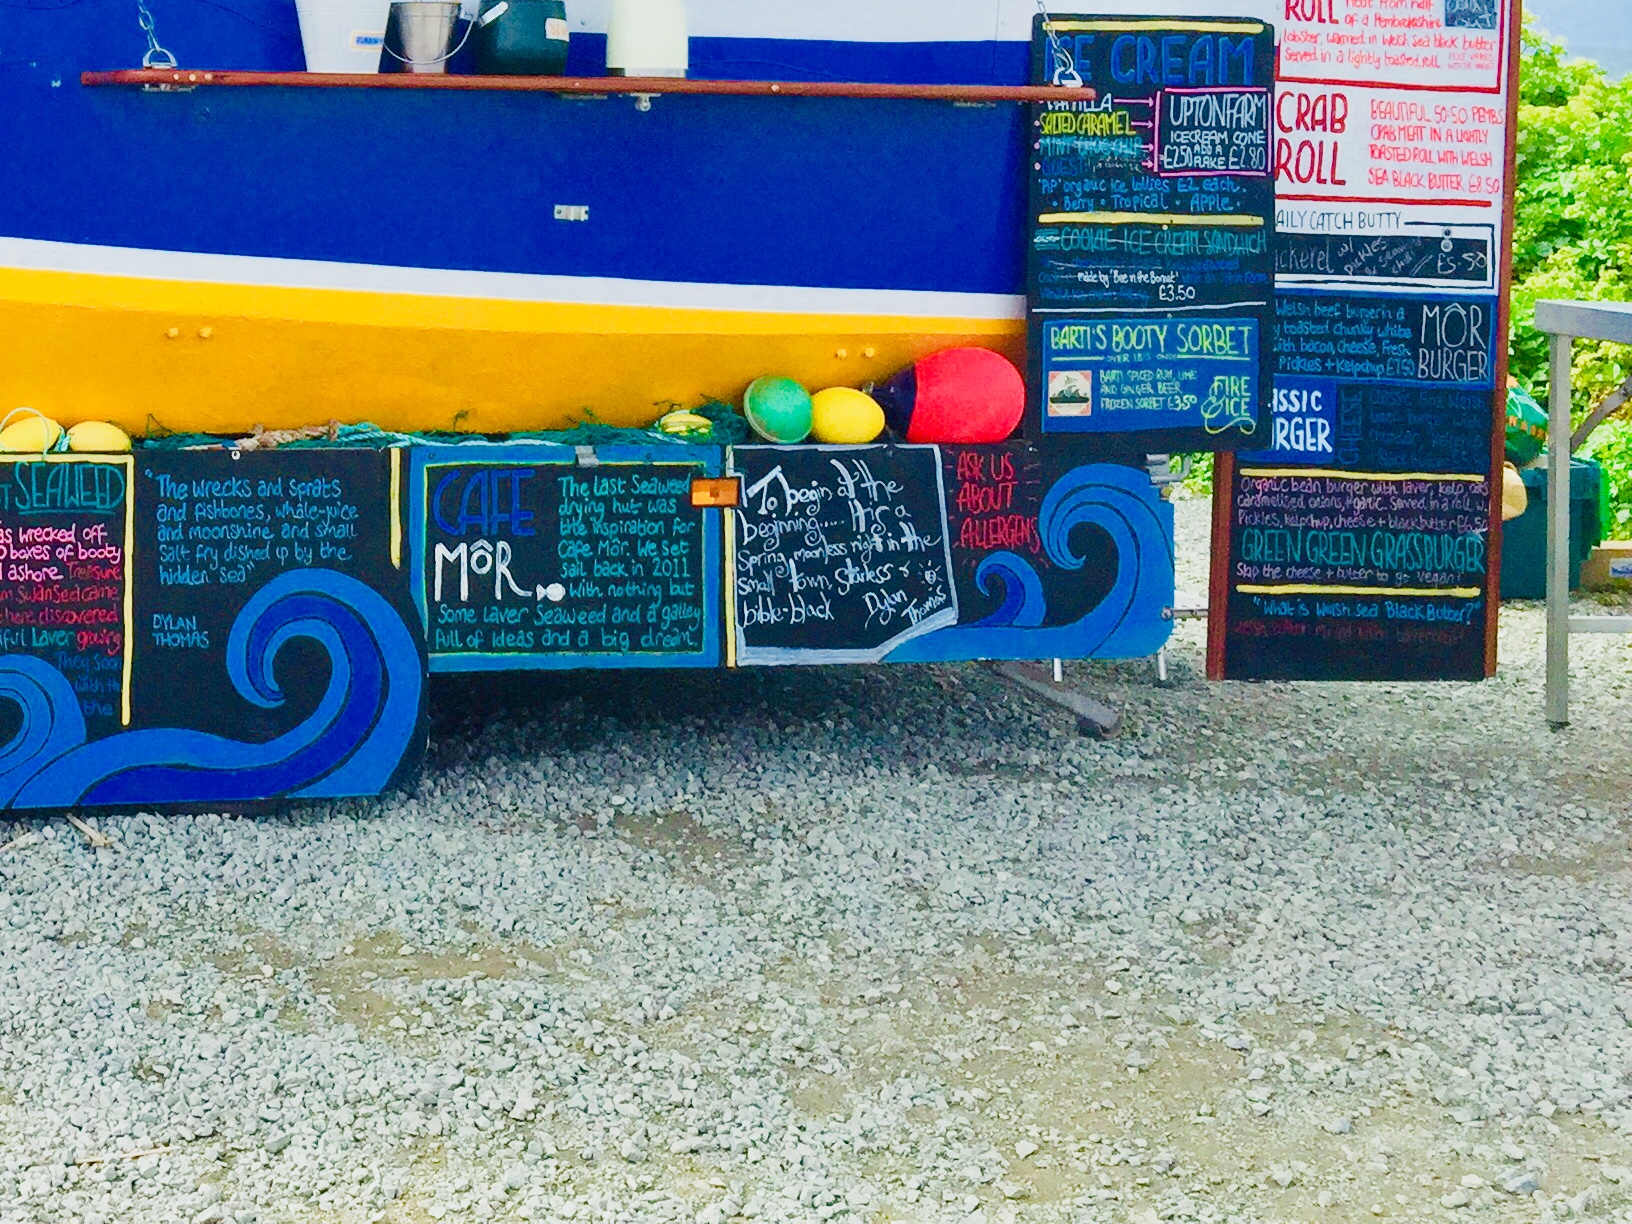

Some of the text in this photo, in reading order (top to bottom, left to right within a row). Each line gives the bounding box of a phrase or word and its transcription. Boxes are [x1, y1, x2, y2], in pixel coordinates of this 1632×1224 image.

[1110, 34, 1254, 85] CREAM
[1040, 111, 1137, 135] SALTED CARAMEL
[1277, 91, 1348, 134] CRAB
[1275, 138, 1346, 186] ROLL
[1393, 172, 1425, 188] BLACK
[1428, 174, 1464, 191] BUTTER
[1310, 210, 1401, 231] CATCH BUTTY
[1159, 286, 1196, 301] £3.50
[1050, 325, 1252, 354] BARTI'S BOOTY SORBET
[1421, 303, 1487, 348] MÔR
[1418, 348, 1488, 381] BURGER
[957, 452, 1014, 481] ASK US
[433, 470, 536, 536] CAFE
[560, 498, 676, 522] drying hut was
[957, 481, 1018, 514] ABOUT
[189, 523, 358, 540] moonshine and small
[960, 515, 1040, 553] ALLERGENS
[1242, 530, 1366, 566] GREEN GREEN
[434, 539, 533, 602] MÔR
[652, 559, 689, 577] 2011
[152, 614, 196, 630] DYLAN
[742, 592, 834, 627] bible-black
[865, 589, 908, 629] Dylan
[152, 631, 208, 648] THOMAS
